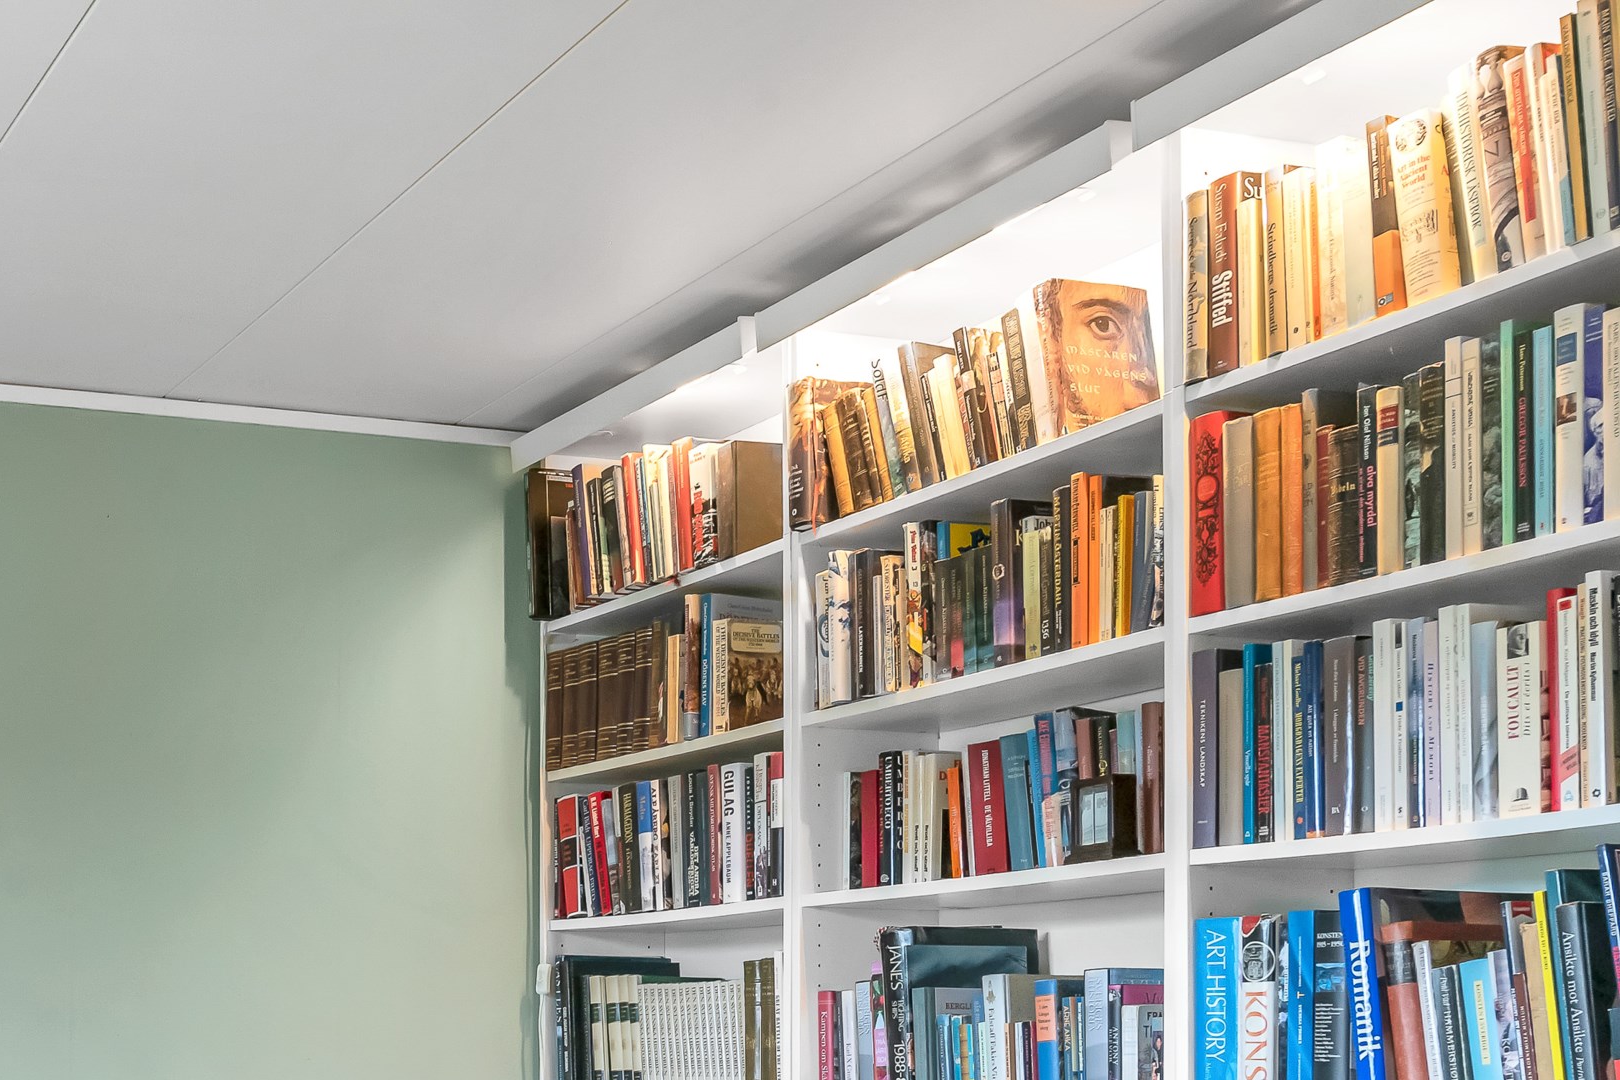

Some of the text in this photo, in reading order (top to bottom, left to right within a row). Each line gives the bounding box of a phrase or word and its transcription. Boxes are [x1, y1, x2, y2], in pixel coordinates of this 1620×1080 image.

[1600, 8, 1616, 122] MAIN STREET REVISITED
[1455, 92, 1483, 230] IDÉHISTORISK LÄSEBOK
[1214, 183, 1227, 264] Susan Faludi
[1212, 270, 1233, 328] Stiffed
[1267, 222, 1278, 336] Strindbergs dramatik
[1187, 281, 1198, 348] Northland
[1065, 345, 1138, 362] MÄSTAREN
[1068, 363, 1147, 382] VID VÄGENS
[1070, 382, 1101, 393] SLUT
[1363, 418, 1371, 433] Olof
[1363, 434, 1371, 460] Nilsson
[1517, 397, 1528, 488] GREGOR PAULSSON
[1366, 466, 1377, 527] alva myrdal
[1053, 496, 1062, 607] MARTIN ÖSTERDAHL
[1041, 545, 1050, 639] Bernard Cornwell 1356
[1589, 587, 1598, 615] Maskin
[1588, 631, 1598, 647] idyll
[1589, 616, 1598, 630] och
[1507, 666, 1520, 740] FOUCAULT
[981, 750, 989, 779] JONATHAN
[1257, 725, 1270, 814] MANSFANTASIER
[723, 770, 735, 817] GULAG
[884, 756, 892, 829] UMBERTO ECO
[984, 805, 991, 813] DE
[583, 816, 591, 833] Bildt
[623, 793, 634, 844] HARMAGEDON
[985, 814, 993, 847] VÄLVILLIGA
[585, 836, 594, 877] UPPDRAG
[1601, 871, 1618, 936] SARAH SHEPPARD
[1562, 931, 1576, 977] Ansikte
[887, 945, 903, 990] JANE'S
[897, 999, 905, 1032] FIGHTING
[1205, 929, 1227, 1063] ART HISTORY
[1349, 939, 1381, 1061] Romanik
[1567, 980, 1578, 1004] mot
[819, 1011, 828, 1047] Kampen
[988, 1008, 997, 1040] Falstaff
[1570, 1008, 1587, 1053] Ansikte
[821, 1049, 827, 1063] om
[989, 1041, 997, 1066] Fakirs
